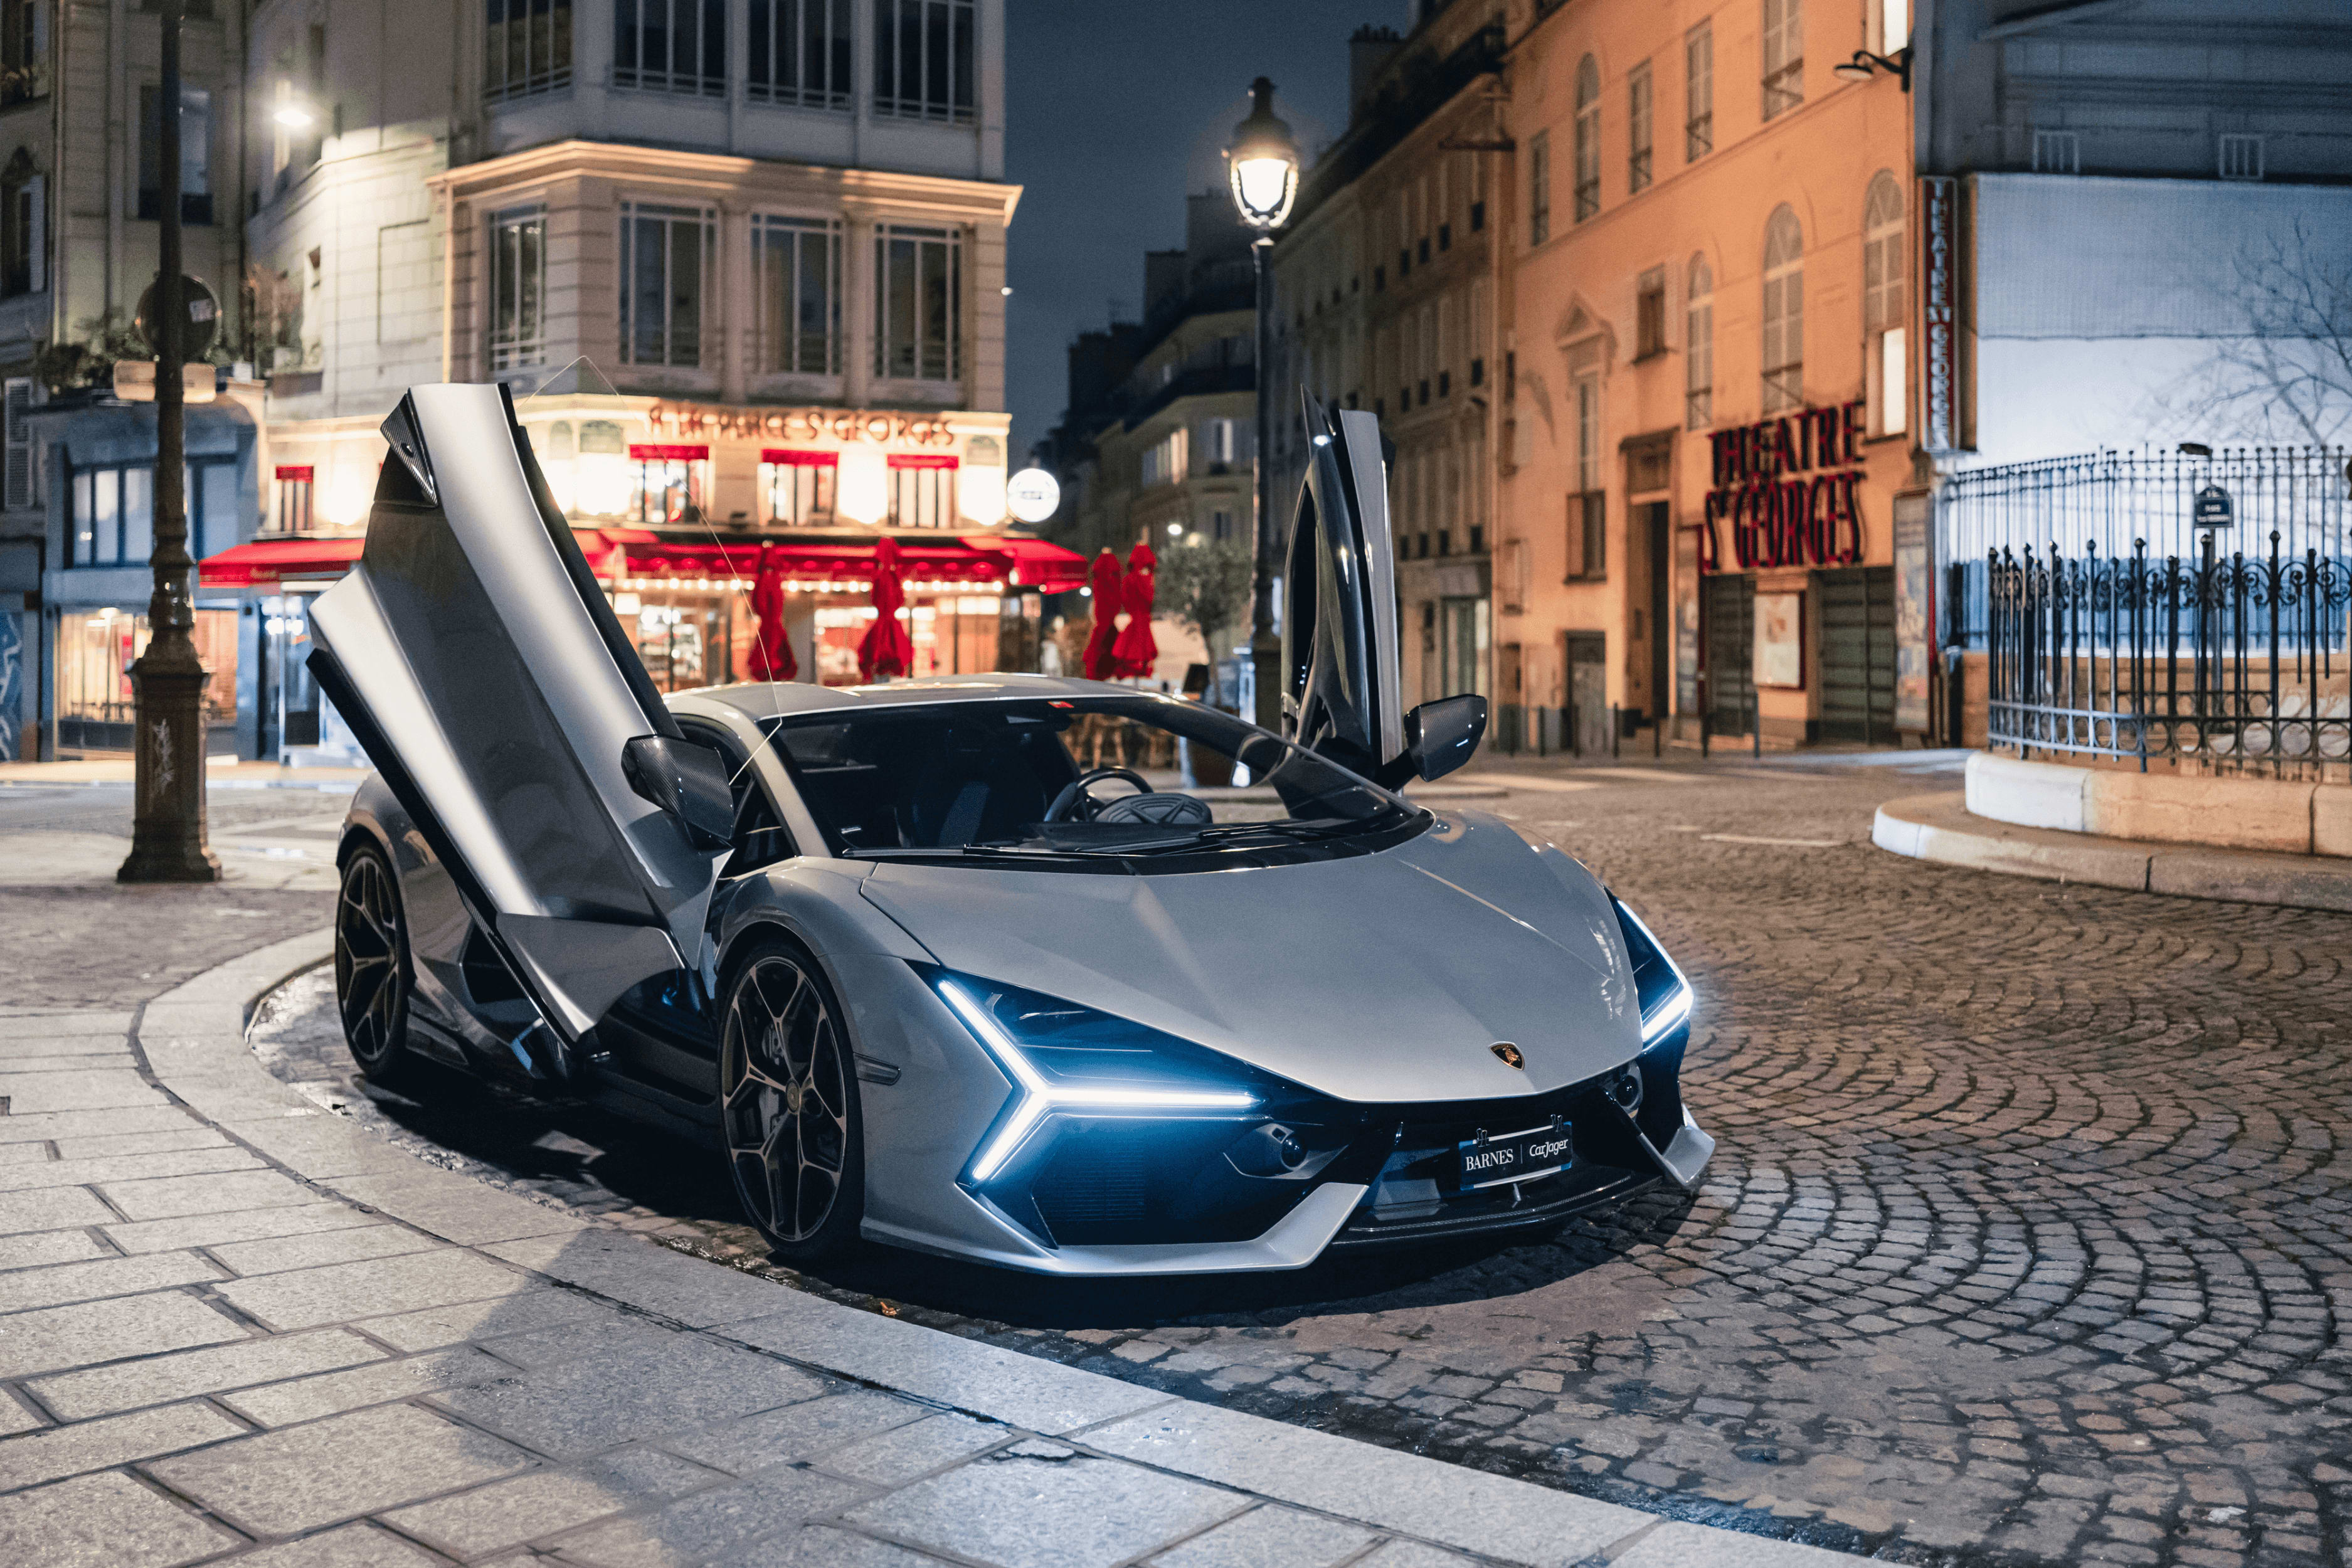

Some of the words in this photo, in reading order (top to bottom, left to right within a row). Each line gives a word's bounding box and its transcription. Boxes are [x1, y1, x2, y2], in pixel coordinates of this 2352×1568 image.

[1928, 177, 1950, 307] THEATRE
[1735, 470, 1868, 568] GEORGES
[1465, 1148, 1513, 1171] BARNES
[1529, 1139, 1569, 1158] CarJager
